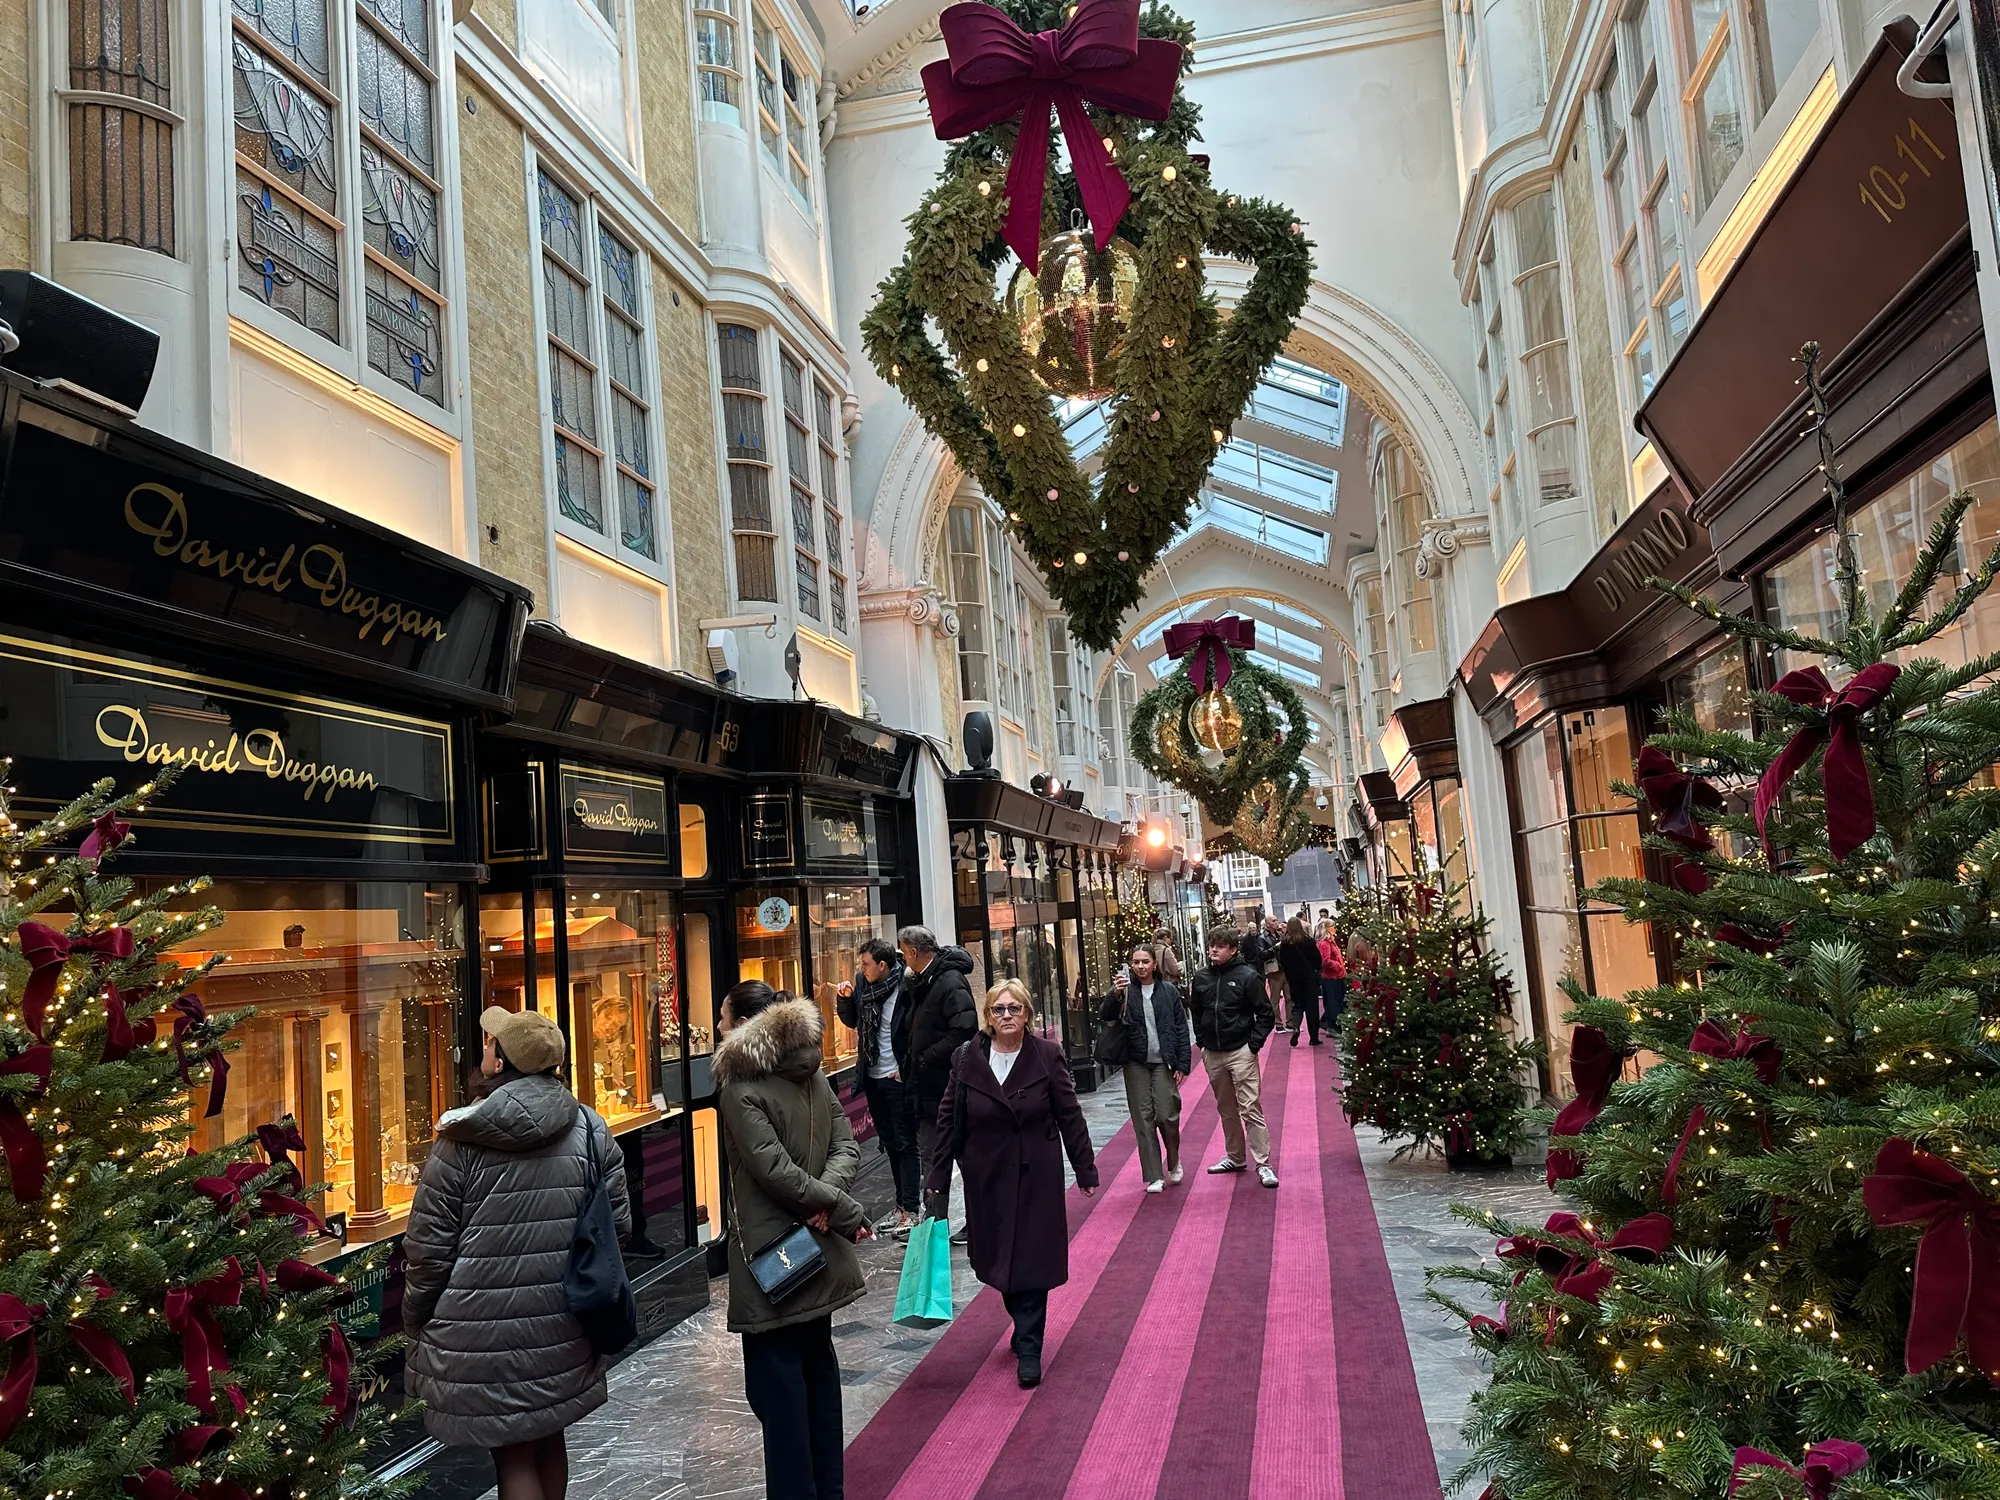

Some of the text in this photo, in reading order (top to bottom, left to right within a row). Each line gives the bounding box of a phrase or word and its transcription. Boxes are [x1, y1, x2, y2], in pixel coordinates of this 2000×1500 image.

[1858, 116, 1945, 223] 10-11
[255, 222, 338, 289] SWEETMEATS
[367, 296, 420, 341] BONBONS
[124, 482, 448, 645] David Duggan
[1593, 508, 1686, 612] DI MINNO
[95, 704, 379, 802] David Duggan
[717, 721, 740, 752] 63
[573, 798, 659, 836] David Duggan
[752, 819, 786, 842] David Duggan
[348, 1264, 392, 1294] HILIPPE
[332, 1295, 370, 1321] TCHES
